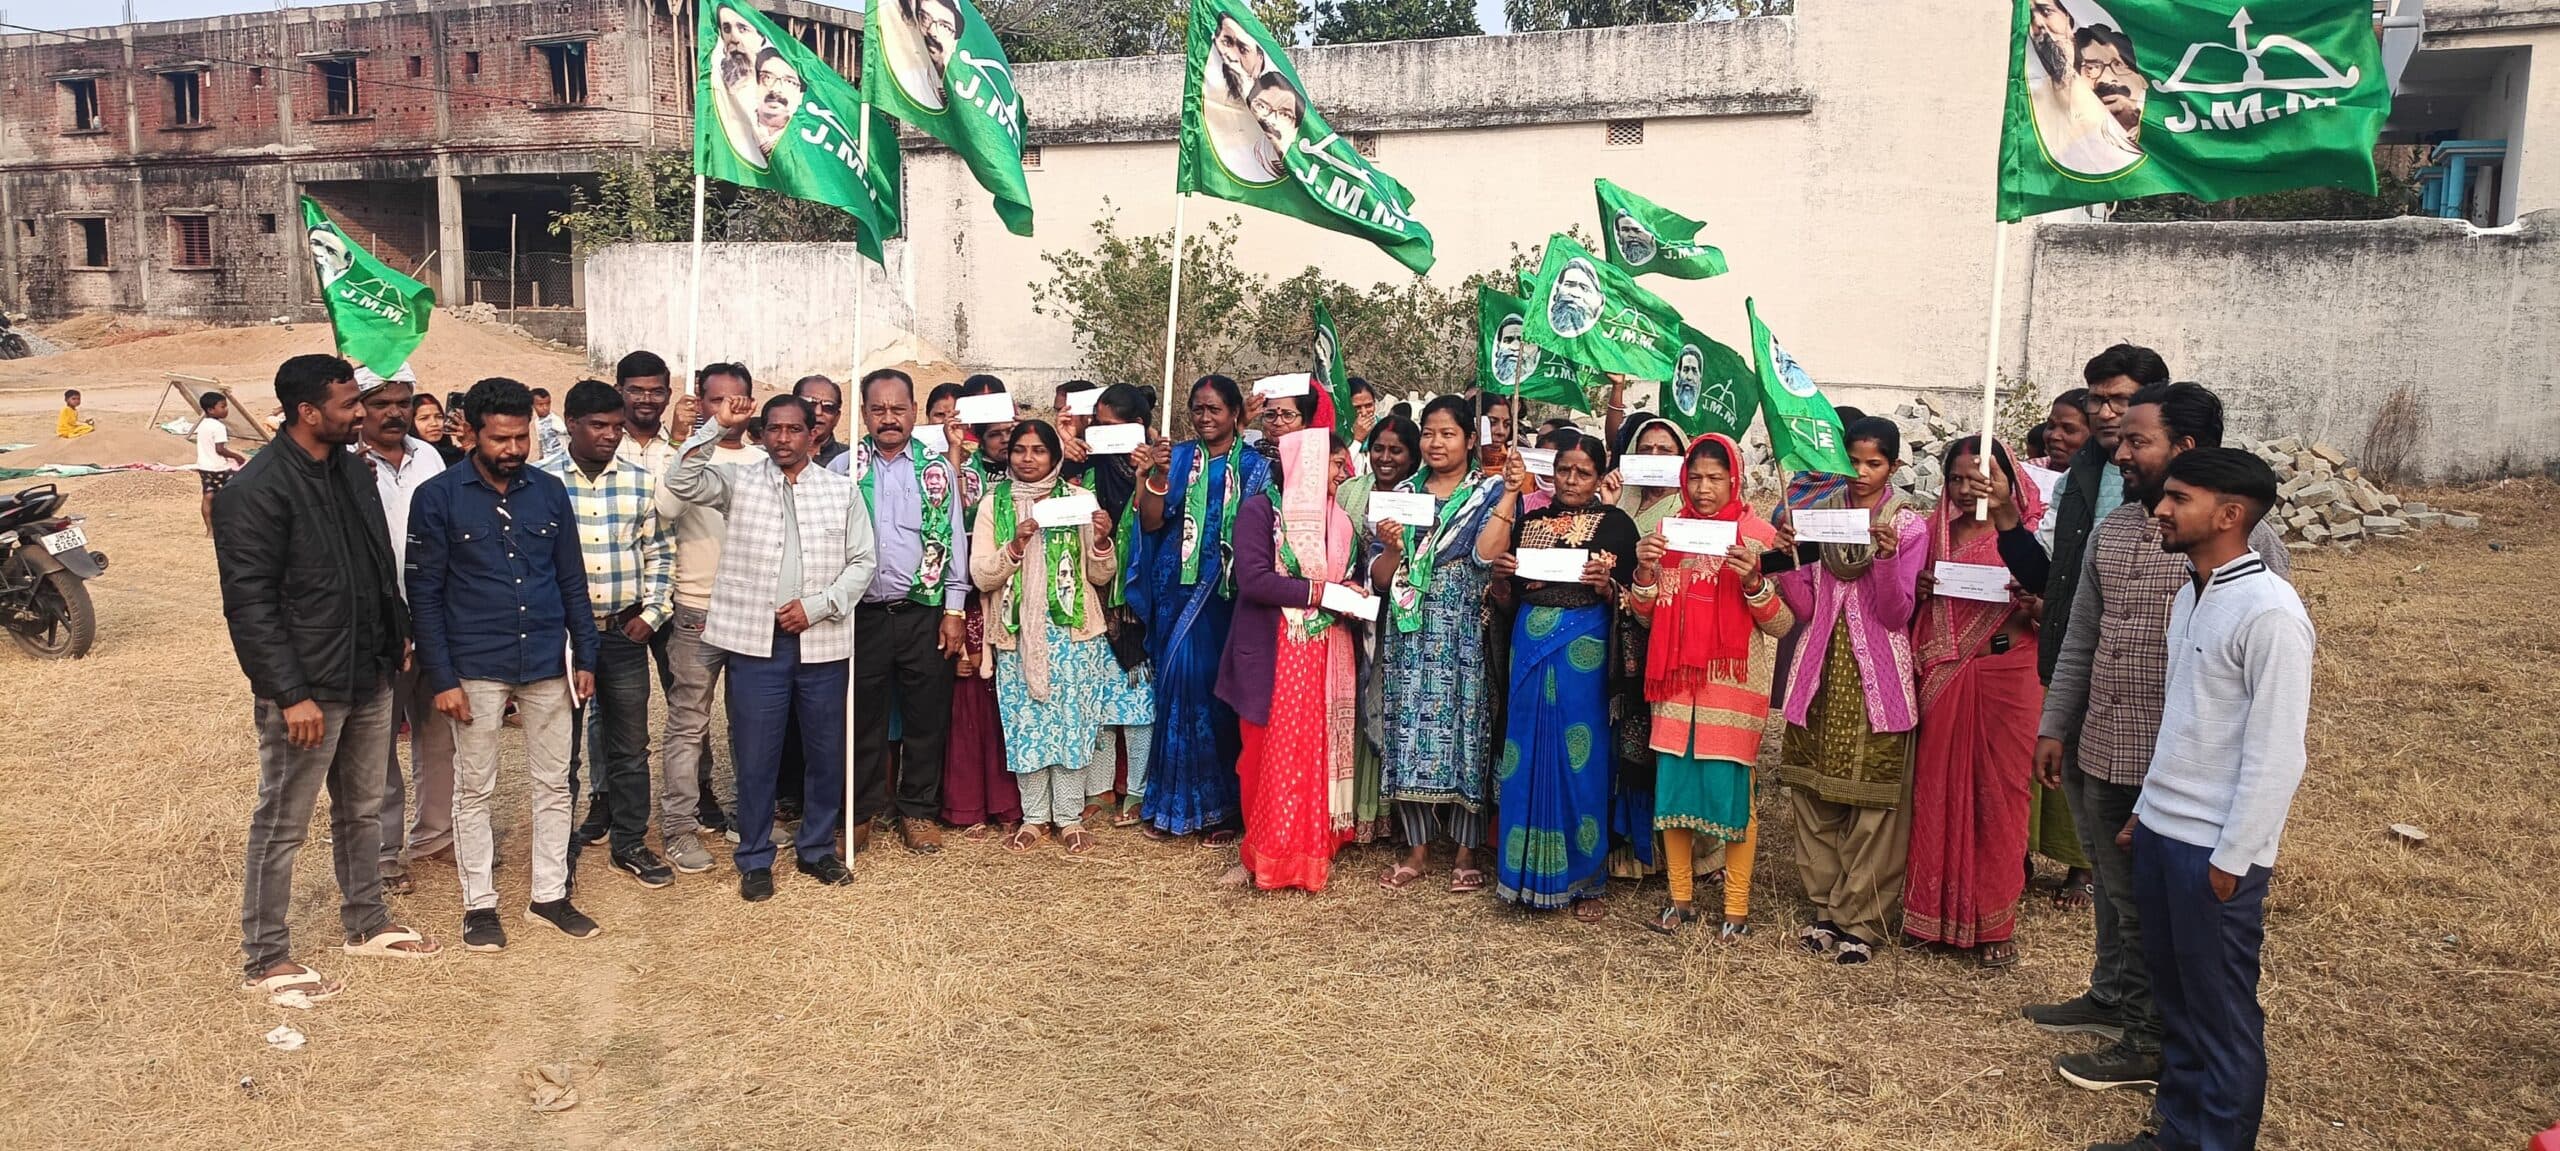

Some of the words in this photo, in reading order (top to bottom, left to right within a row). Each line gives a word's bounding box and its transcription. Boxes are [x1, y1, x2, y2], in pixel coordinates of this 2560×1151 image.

[341, 288, 405, 326] J.M.M.
[1601, 326, 1656, 352] J.M.M.
[1702, 399, 1736, 431] J.M.M.
